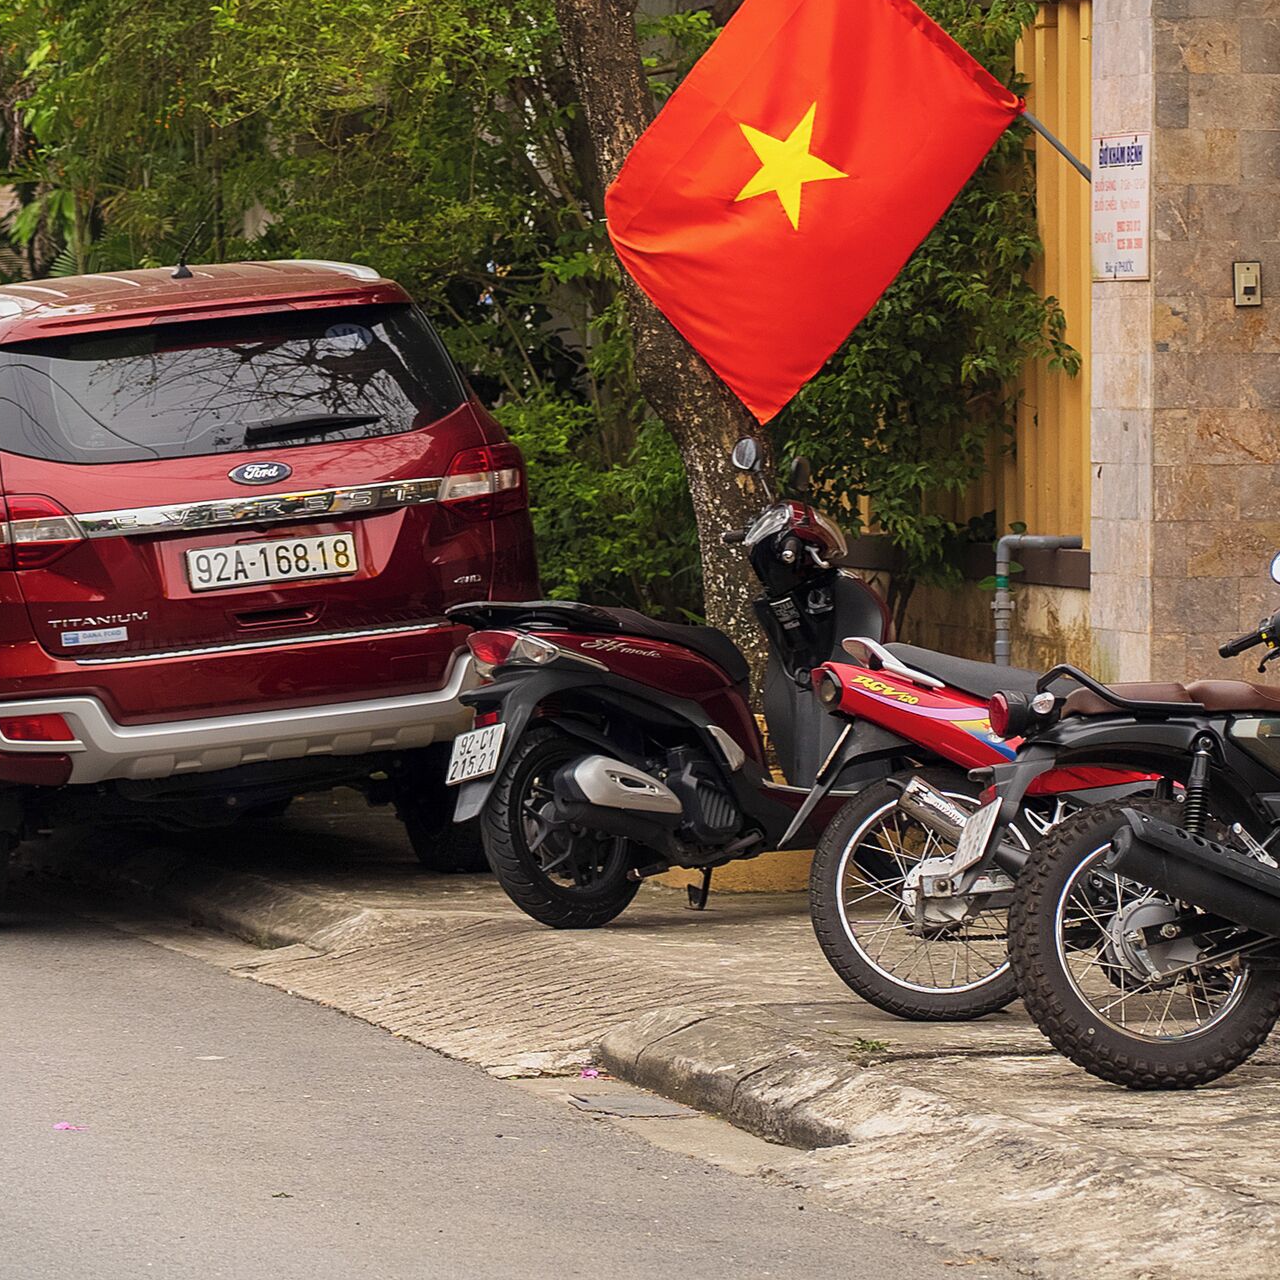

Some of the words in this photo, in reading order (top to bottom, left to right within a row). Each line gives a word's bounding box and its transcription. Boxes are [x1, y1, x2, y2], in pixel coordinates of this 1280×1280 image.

[243, 463, 280, 481] Ford
[112, 483, 416, 529] EVEREST
[195, 538, 351, 585] 92A-168.18
[47, 611, 149, 628] TITANIUM
[450, 749, 496, 781] 215.21
